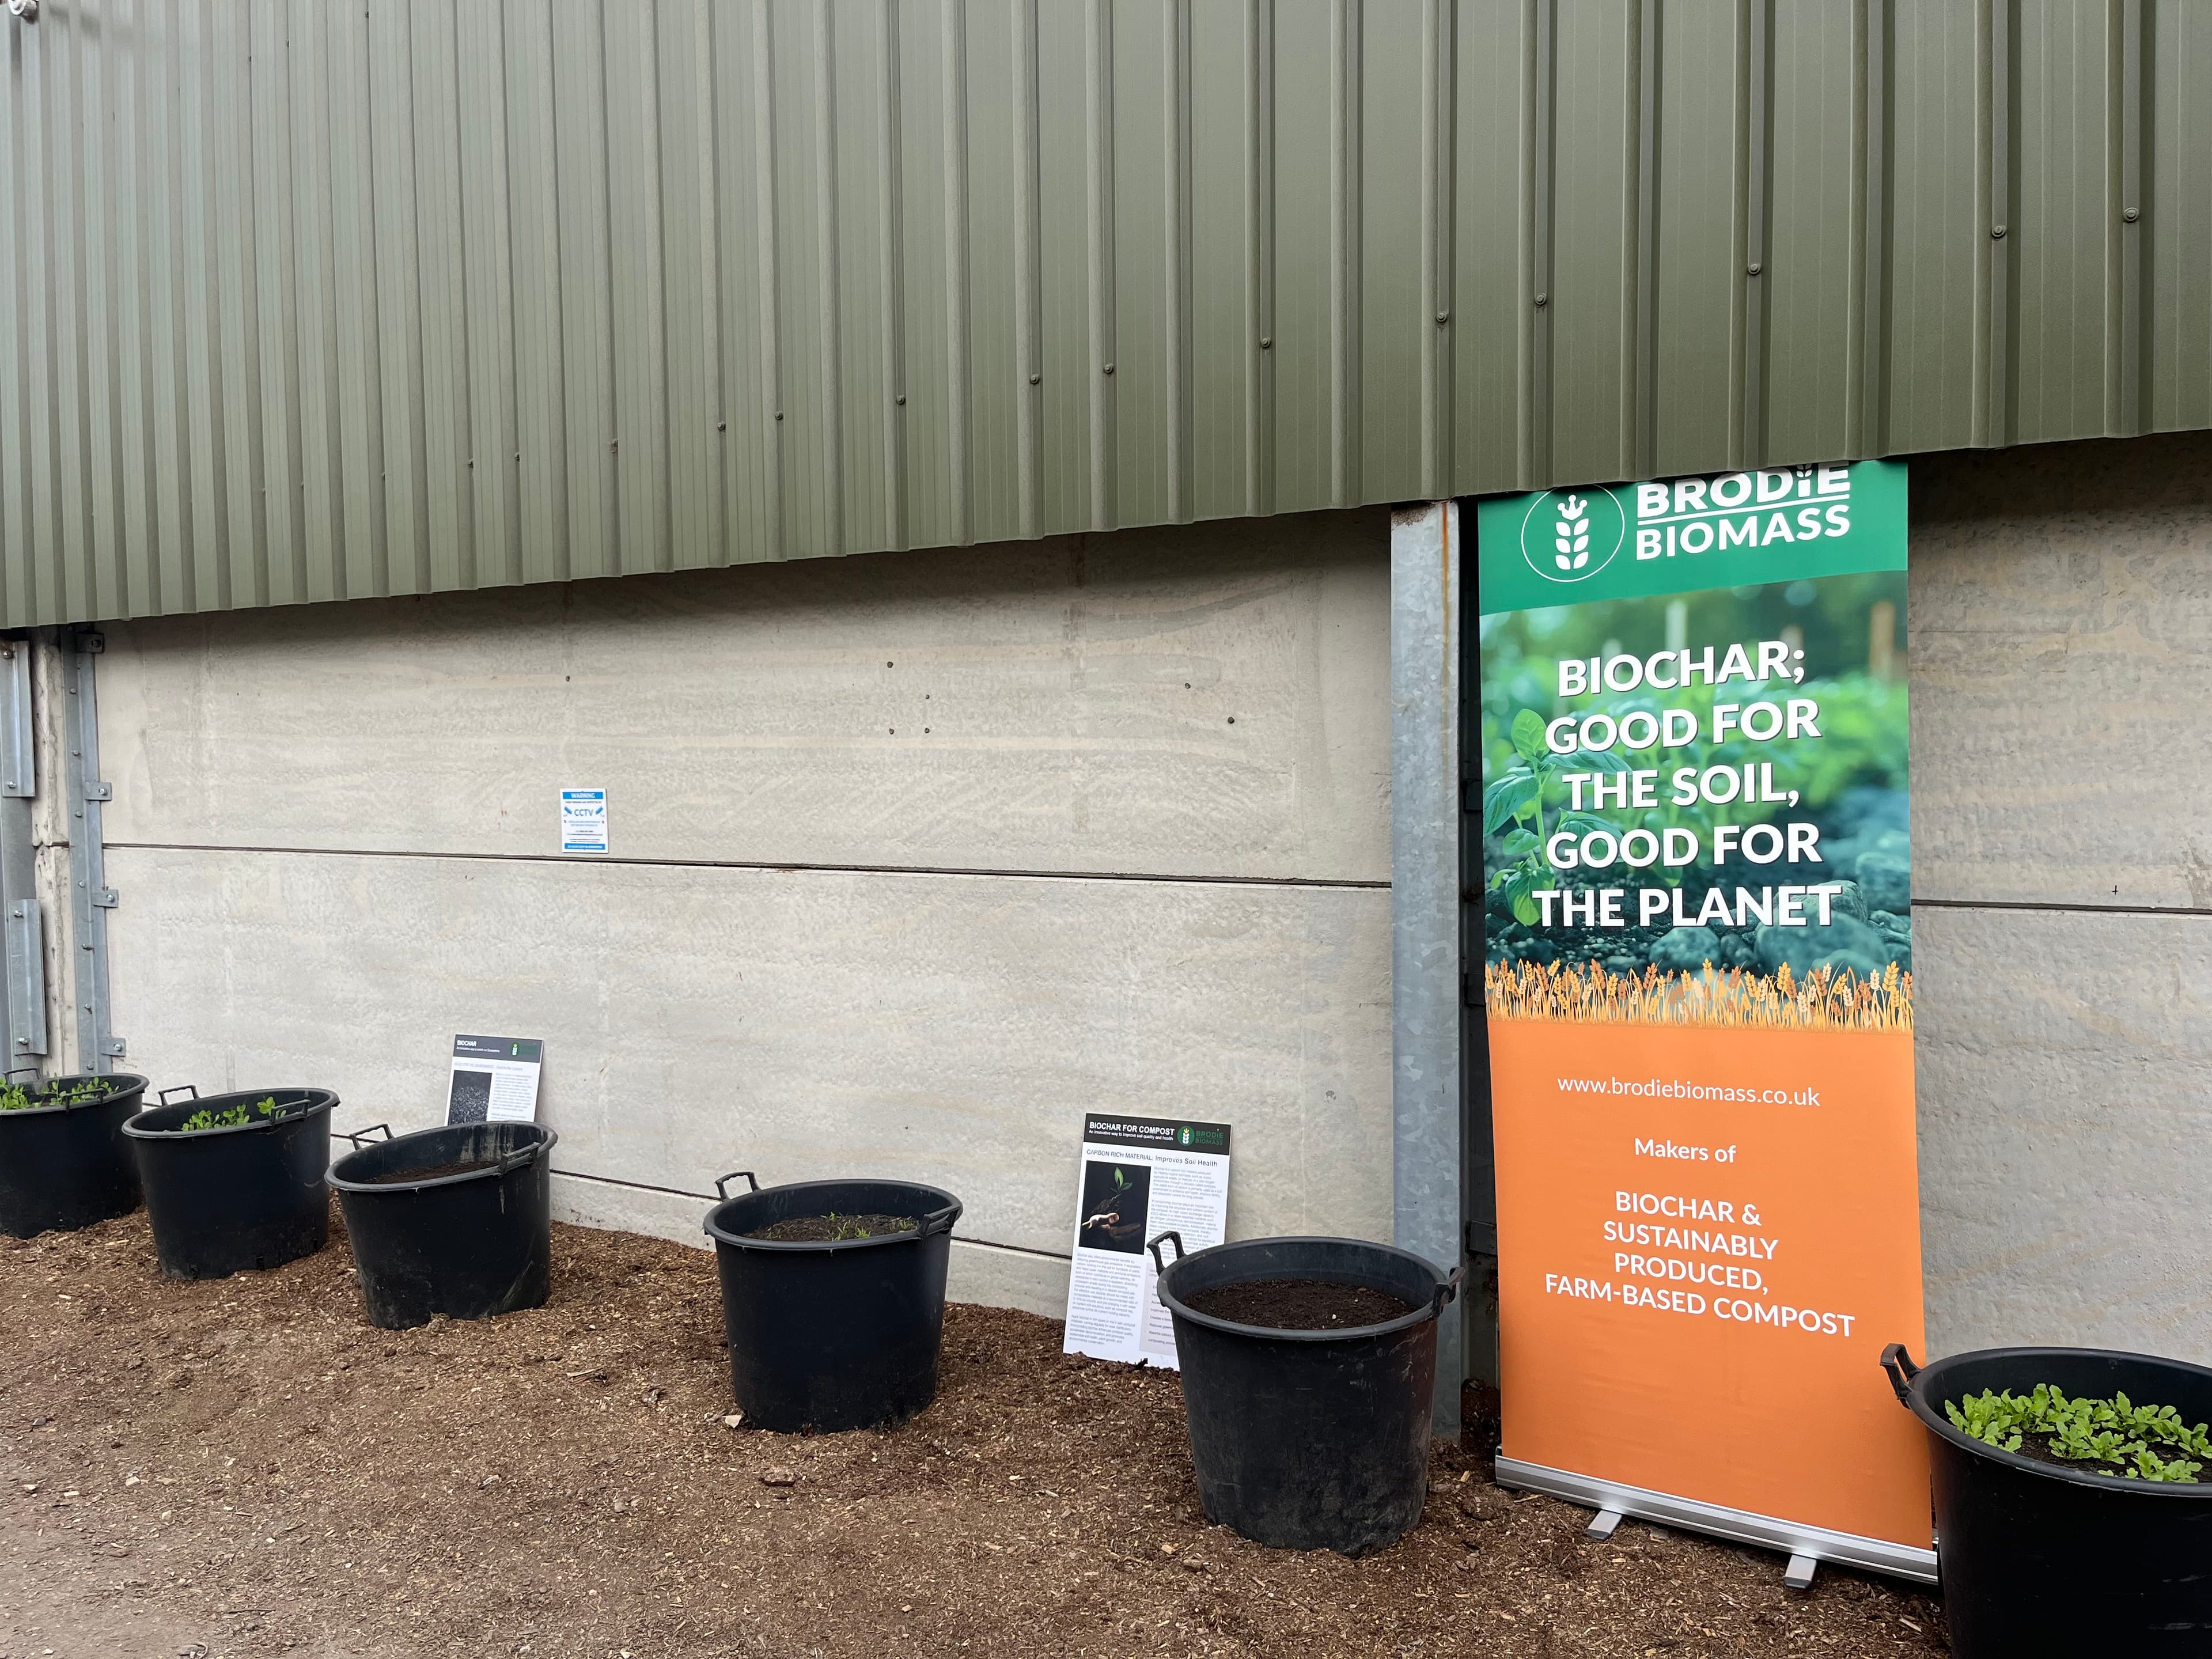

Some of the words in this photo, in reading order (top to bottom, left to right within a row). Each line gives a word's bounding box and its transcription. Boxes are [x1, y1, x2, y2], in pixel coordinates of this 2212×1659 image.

[1637, 505, 1850, 560] BIOMASS
[1559, 641, 1805, 697] BIOCHAR;
[1545, 709, 1698, 754] GOOD
[1713, 699, 1822, 743] FOR
[1562, 767, 1658, 810] THE
[1671, 762, 1800, 808] SOIL,
[1546, 828, 1699, 869] GOOD
[1714, 823, 1823, 865] FOR
[1532, 888, 1624, 927] THE
[1639, 883, 1842, 927] PLANET
[1556, 1077, 1821, 1106] www.brodiebiomass.co.uk
[1089, 1122, 1121, 1131] BIOCHAR
[1122, 1124, 1137, 1132] FOR
[1139, 1126, 1175, 1135] COMPOST
[1195, 1138, 1224, 1146] BIOMASS
[1635, 1138, 1709, 1161] Makers
[1714, 1145, 1736, 1163] of
[1155, 1156, 1183, 1164] Improves
[1616, 1191, 1735, 1223] BIOCHAR
[1741, 1203, 1762, 1226] &
[1604, 1221, 1779, 1260] SUSTAINABLY
[1615, 1252, 1768, 1296] PRODUCED,
[1546, 1274, 1706, 1315] FARM-BASED
[1713, 1297, 1856, 1338] COMPOST
